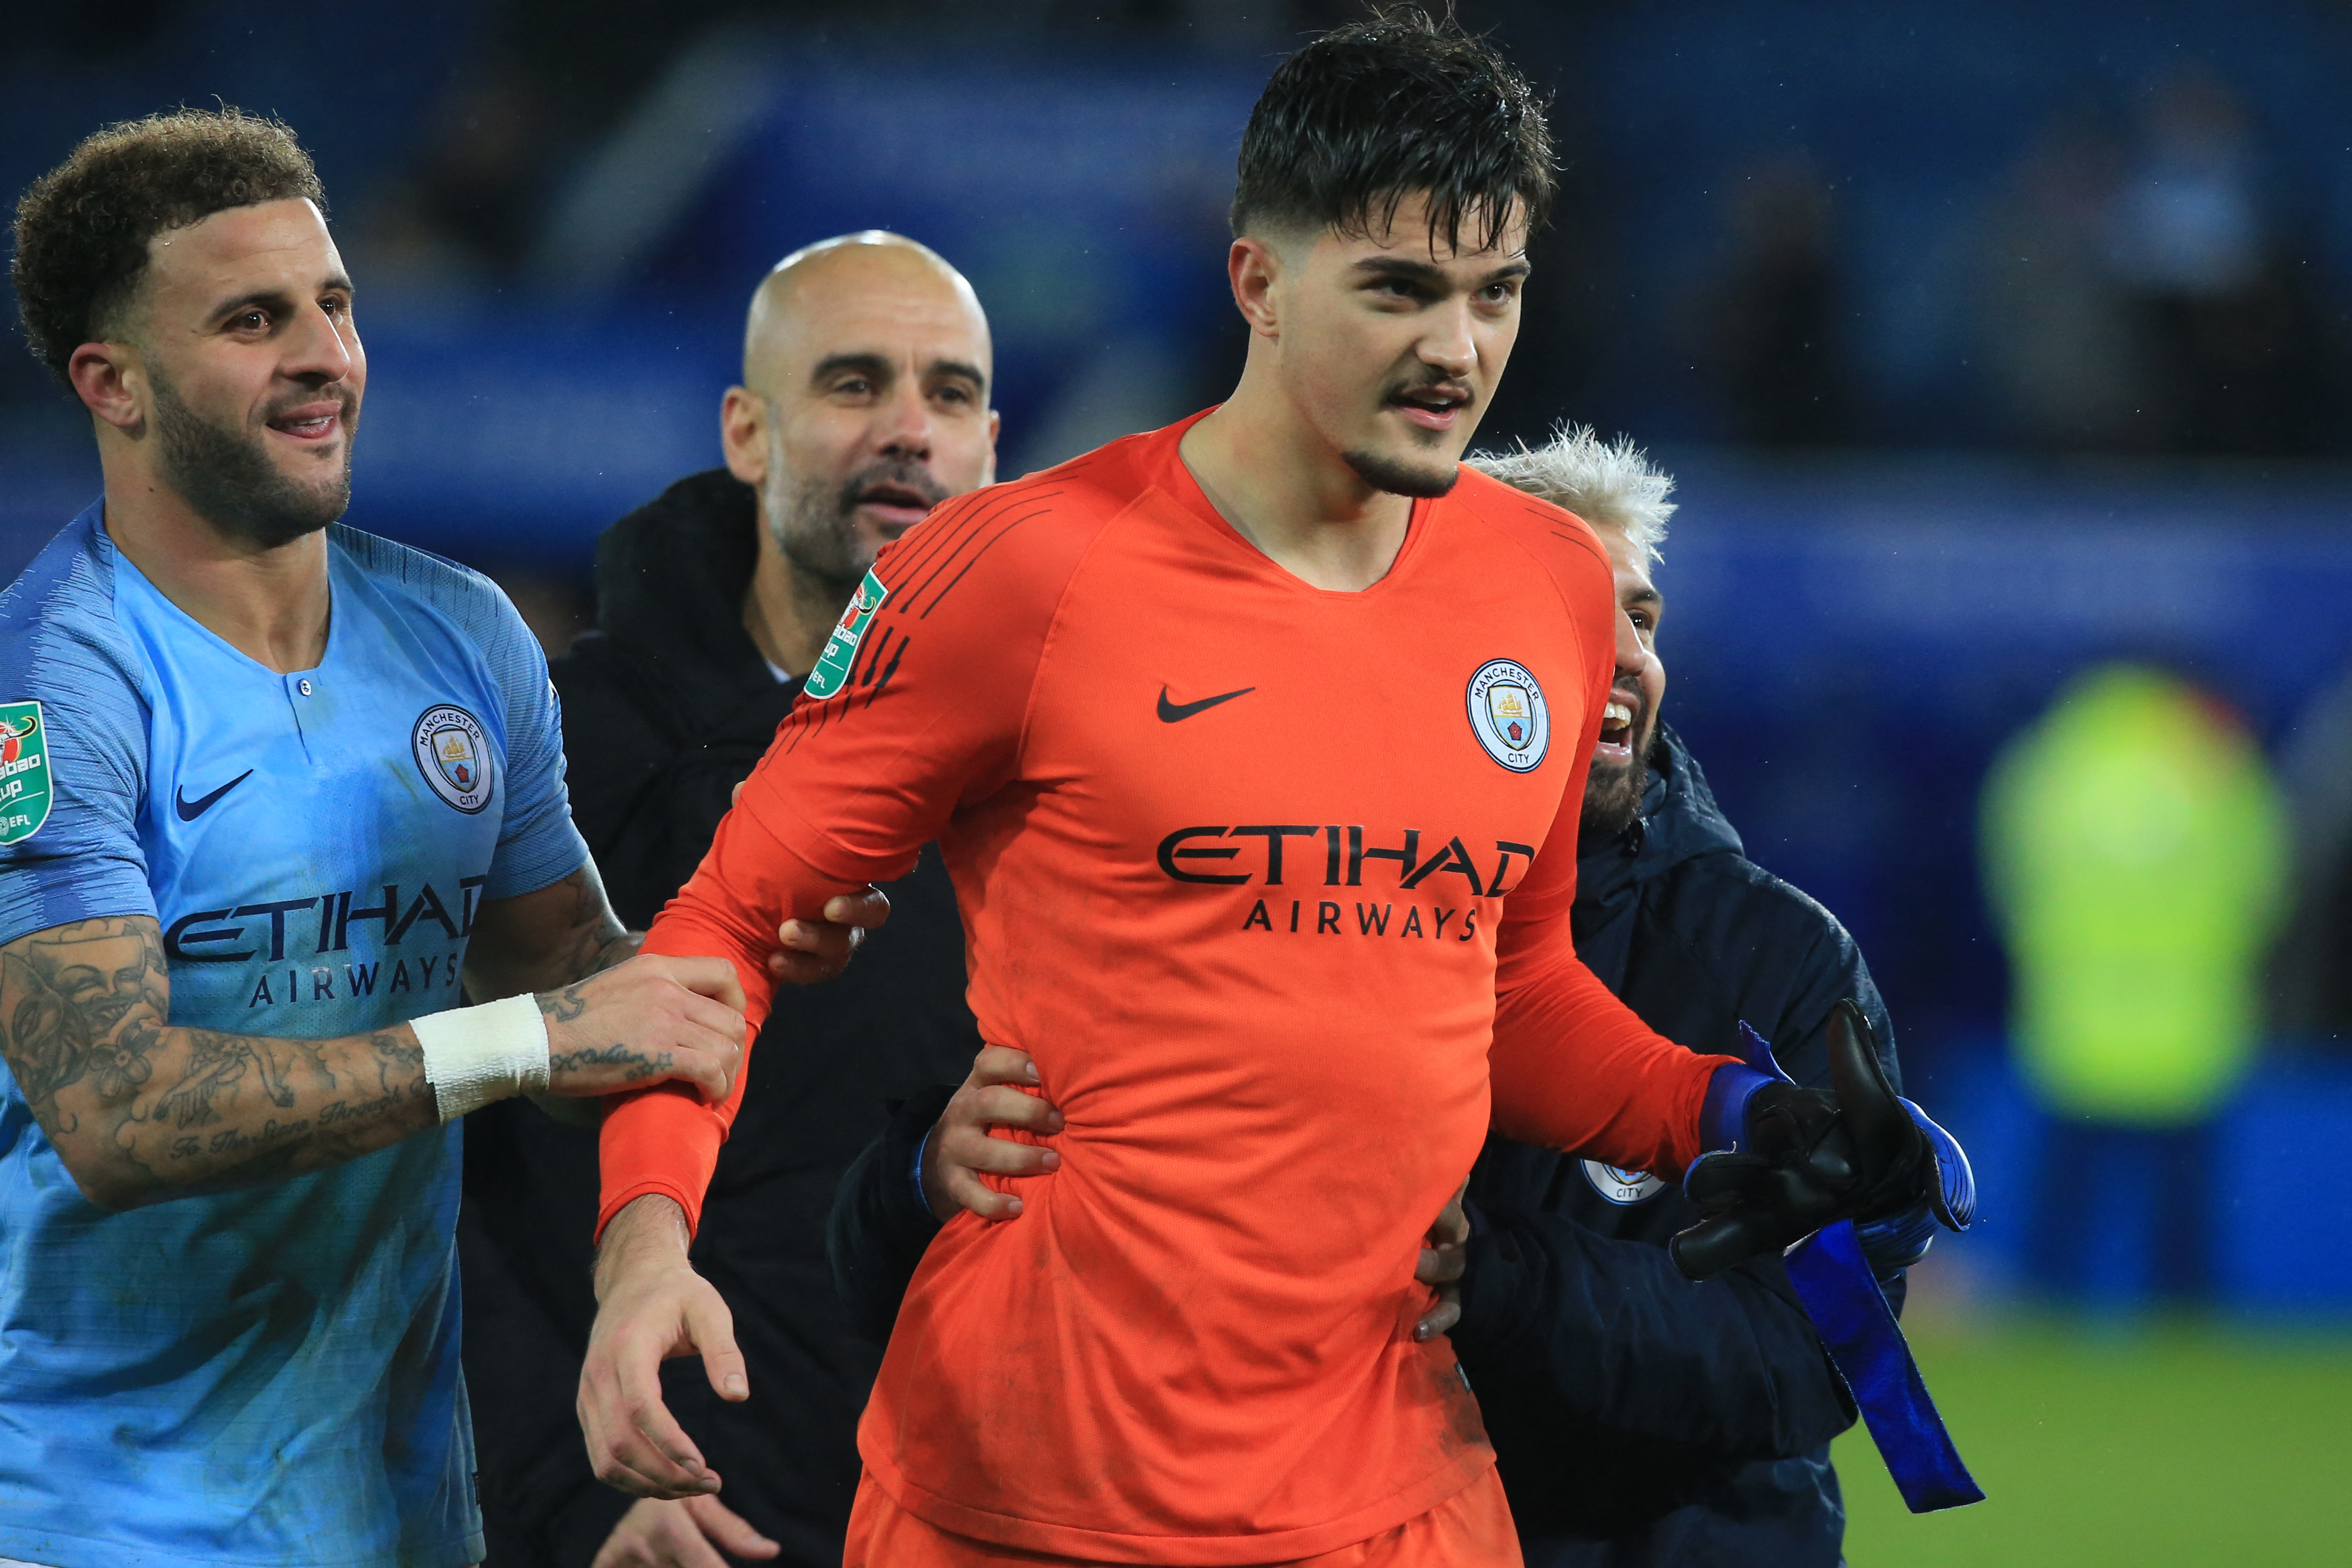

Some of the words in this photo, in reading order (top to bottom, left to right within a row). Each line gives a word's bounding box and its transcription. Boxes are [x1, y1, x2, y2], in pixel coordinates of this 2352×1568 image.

[824, 638, 840, 659] up
[812, 670, 825, 689] EFL
[1475, 667, 1540, 701] MANCHESTER
[420, 713, 480, 747] MANCHESTER
[1508, 753, 1529, 764] CITY
[0, 779, 23, 802] up
[460, 795, 479, 805] CITY
[8, 814, 31, 828] EFL
[1157, 825, 1535, 898] ETIHAD
[1242, 898, 1476, 942] AIRWAYS
[248, 953, 457, 1008] AIRWAYS
[1616, 1188, 1644, 1198] CITY
